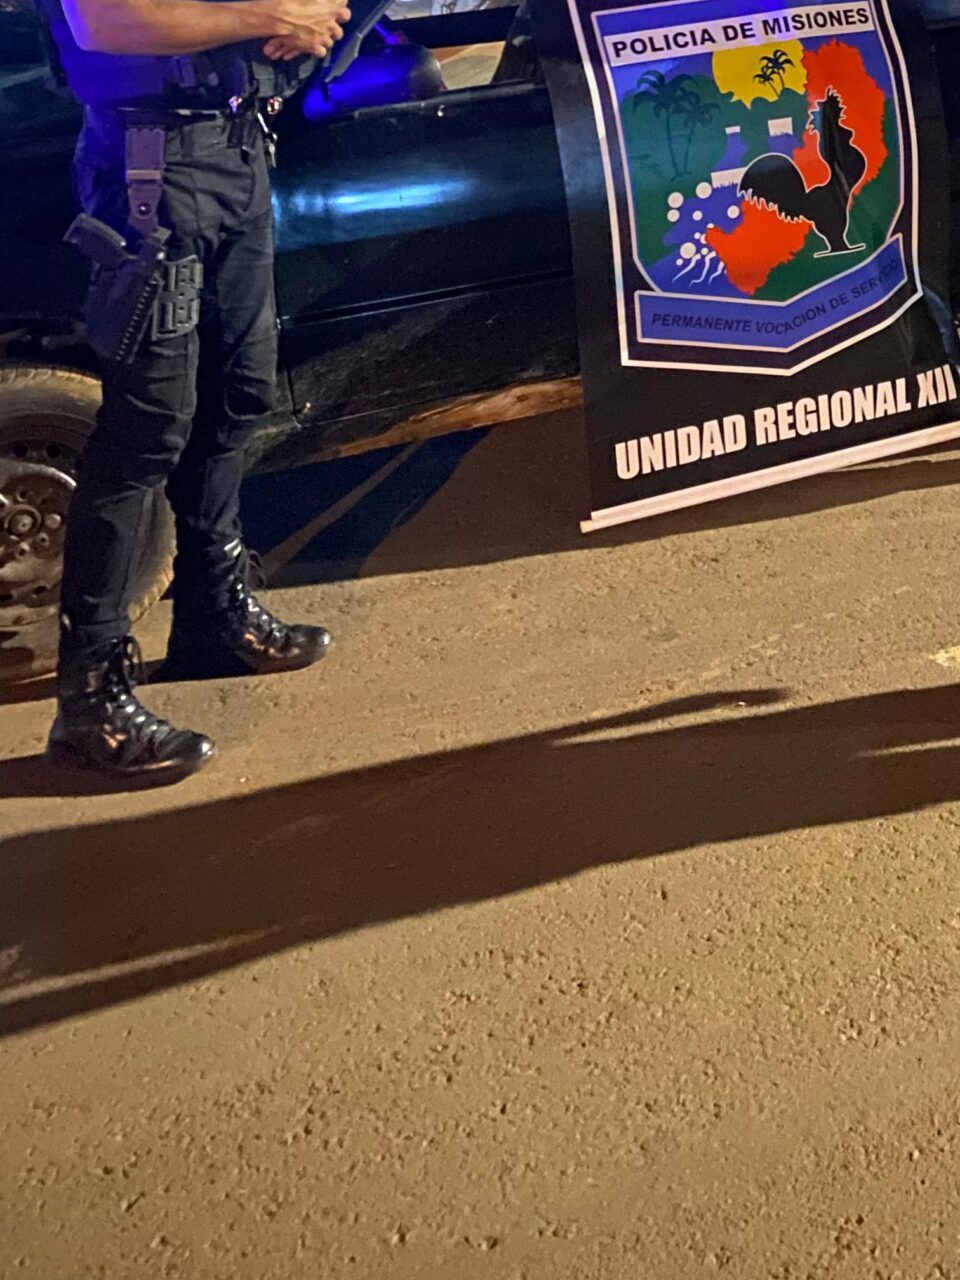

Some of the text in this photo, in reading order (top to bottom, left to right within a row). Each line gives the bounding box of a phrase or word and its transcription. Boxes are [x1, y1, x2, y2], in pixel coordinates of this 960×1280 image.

[612, 8, 870, 58] POLICIA DE MISIONES
[652, 259, 898, 335] PERMANENTE VOCACION DE SERVCIO
[615, 364, 958, 480] UNIDAD REGIONAL XII
